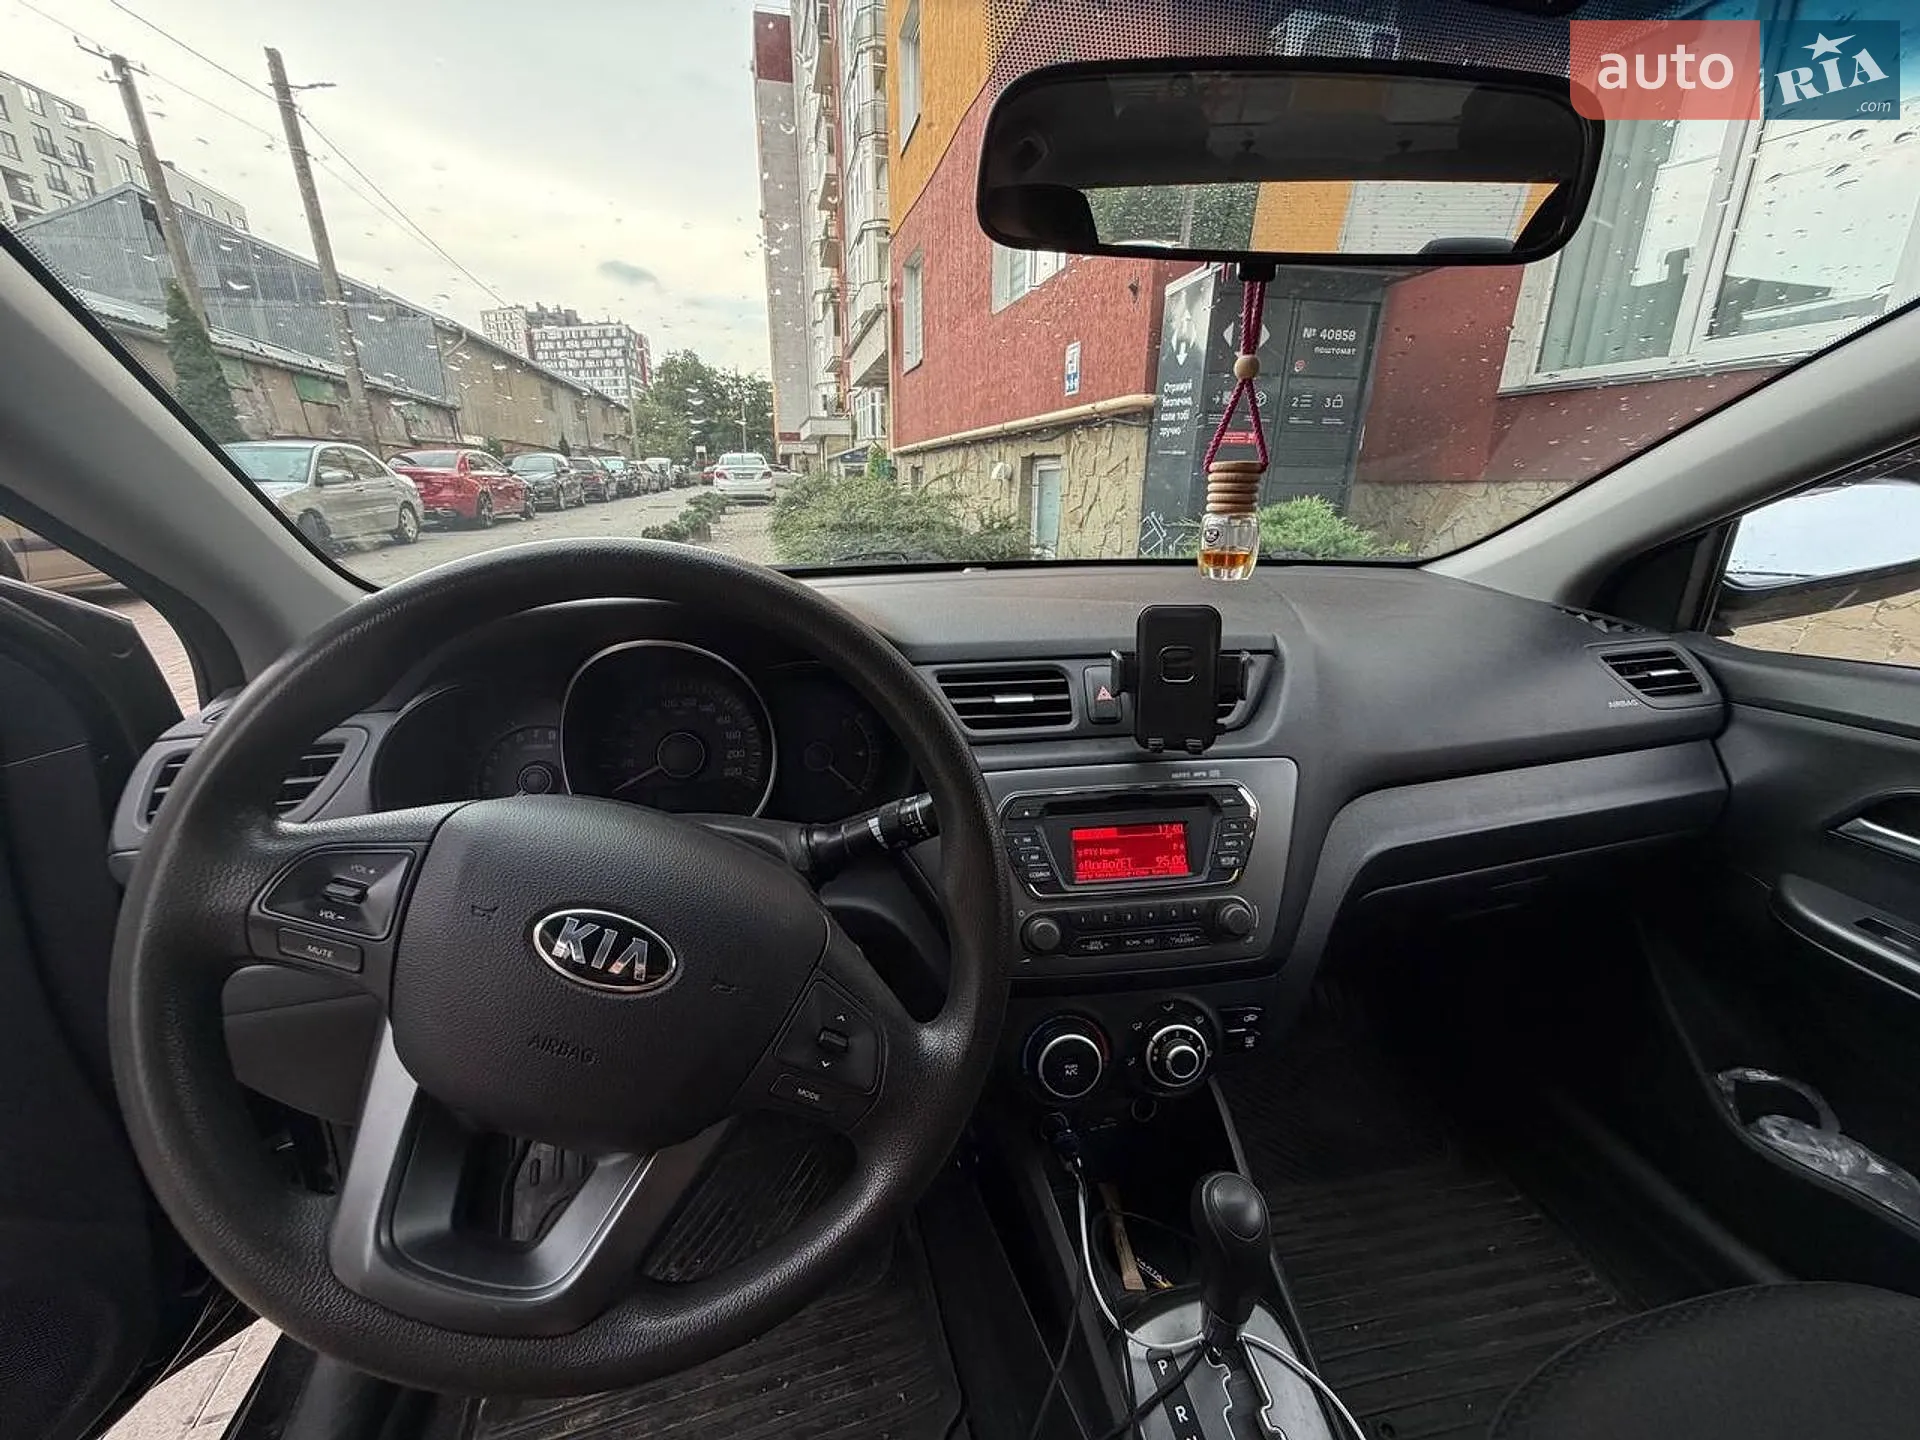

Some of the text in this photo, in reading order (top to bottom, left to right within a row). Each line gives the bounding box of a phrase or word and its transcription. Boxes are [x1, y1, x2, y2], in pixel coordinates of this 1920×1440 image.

[1320, 328, 1356, 342] 40858
[1291, 397, 1298, 407] 2
[1324, 397, 1331, 408] 3
[307, 945, 334, 958] MUTE
[551, 916, 649, 982] KIA
[527, 1034, 600, 1065] AIRBAG
[798, 1087, 821, 1101] MODE
[1157, 1359, 1168, 1376] P
[1175, 1405, 1188, 1423] R
